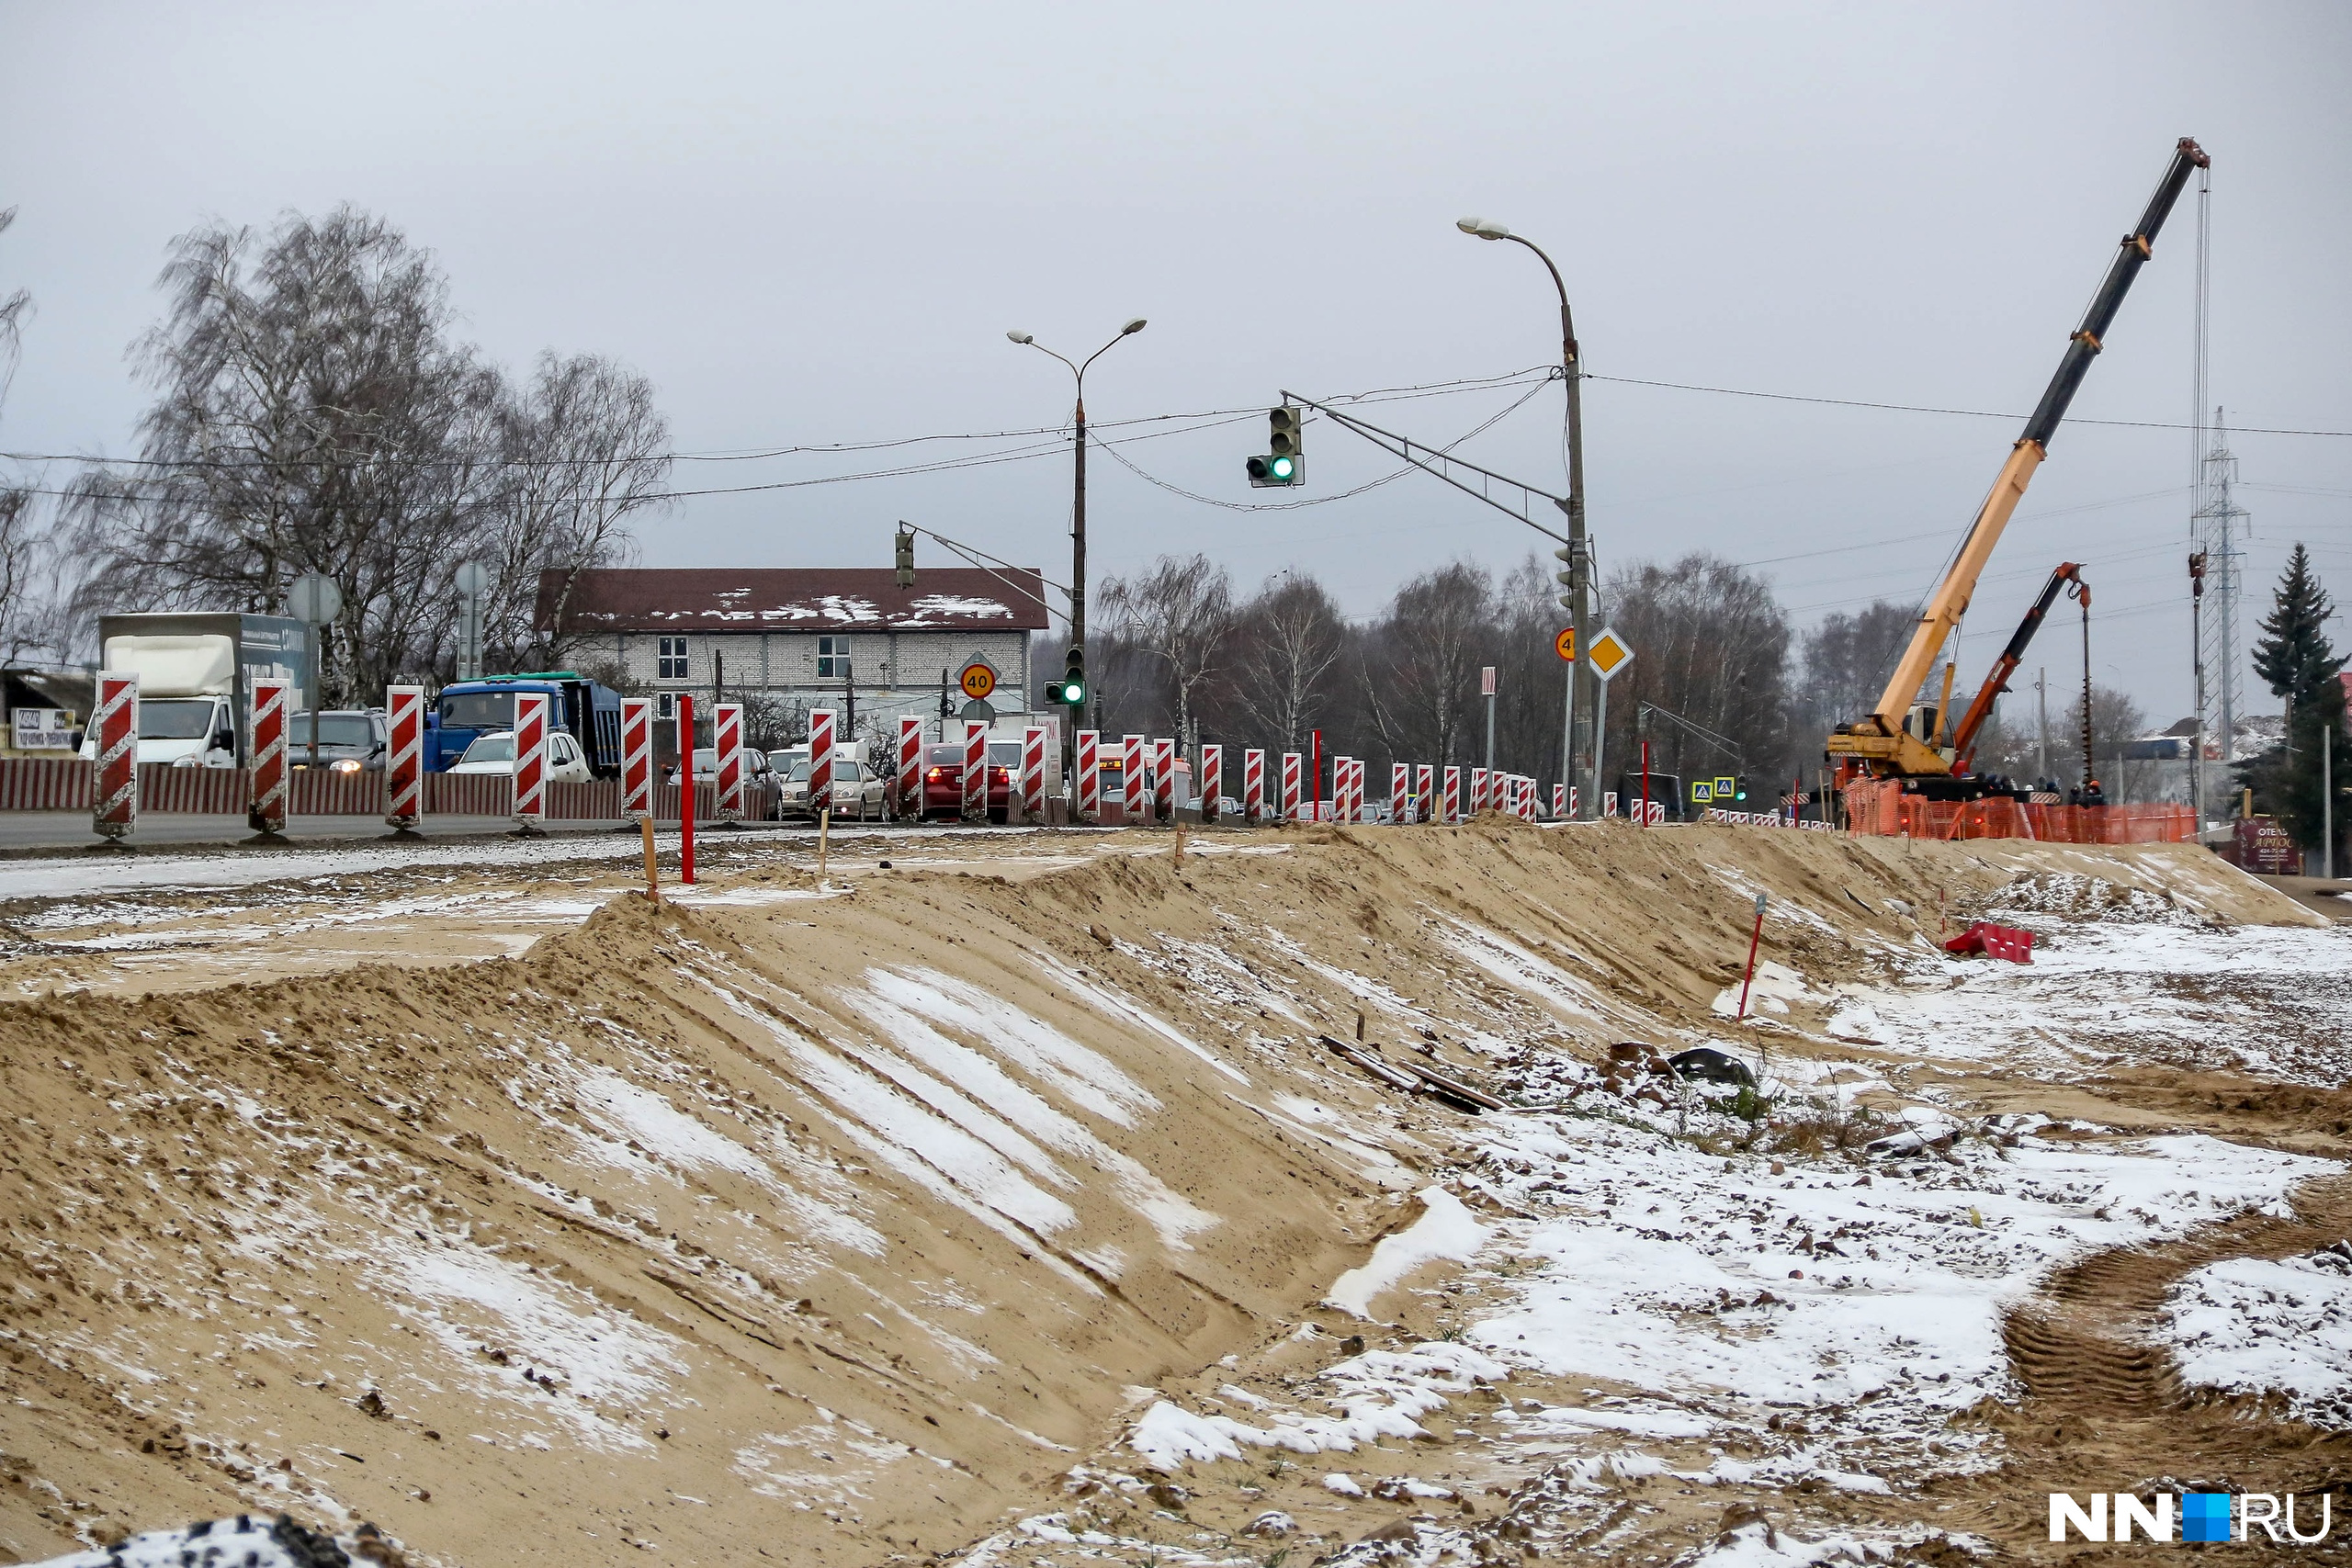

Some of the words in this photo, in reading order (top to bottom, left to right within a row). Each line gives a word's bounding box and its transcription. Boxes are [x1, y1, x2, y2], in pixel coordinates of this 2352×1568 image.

[1562, 638, 1575, 650] 4
[967, 675, 988, 689] 40
[2258, 828, 2289, 836] ОТЕЛЬ
